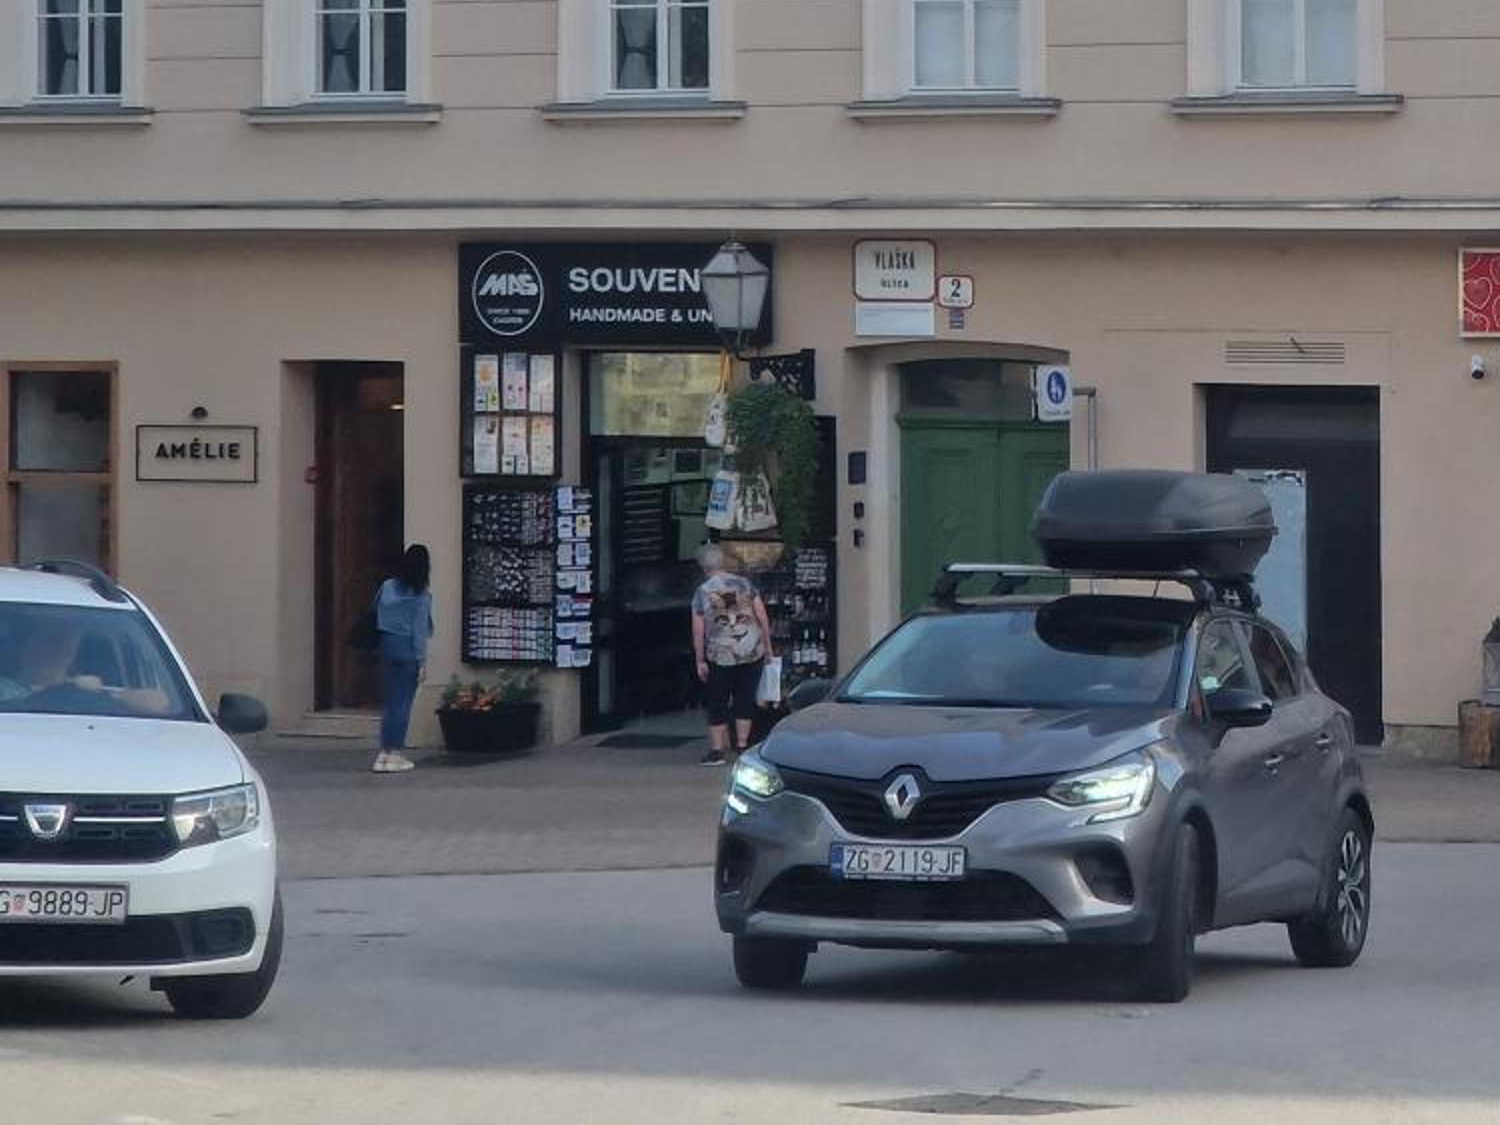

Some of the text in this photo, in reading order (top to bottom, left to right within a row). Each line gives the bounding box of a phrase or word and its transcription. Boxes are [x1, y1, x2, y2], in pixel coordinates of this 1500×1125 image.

[875, 247, 916, 270] VLAŠKA
[568, 267, 702, 293] SOUVEN
[951, 278, 961, 298] 2
[569, 308, 713, 322] HANDMADE & UN
[155, 437, 241, 460] AMÉLIE
[846, 849, 870, 872] ZG
